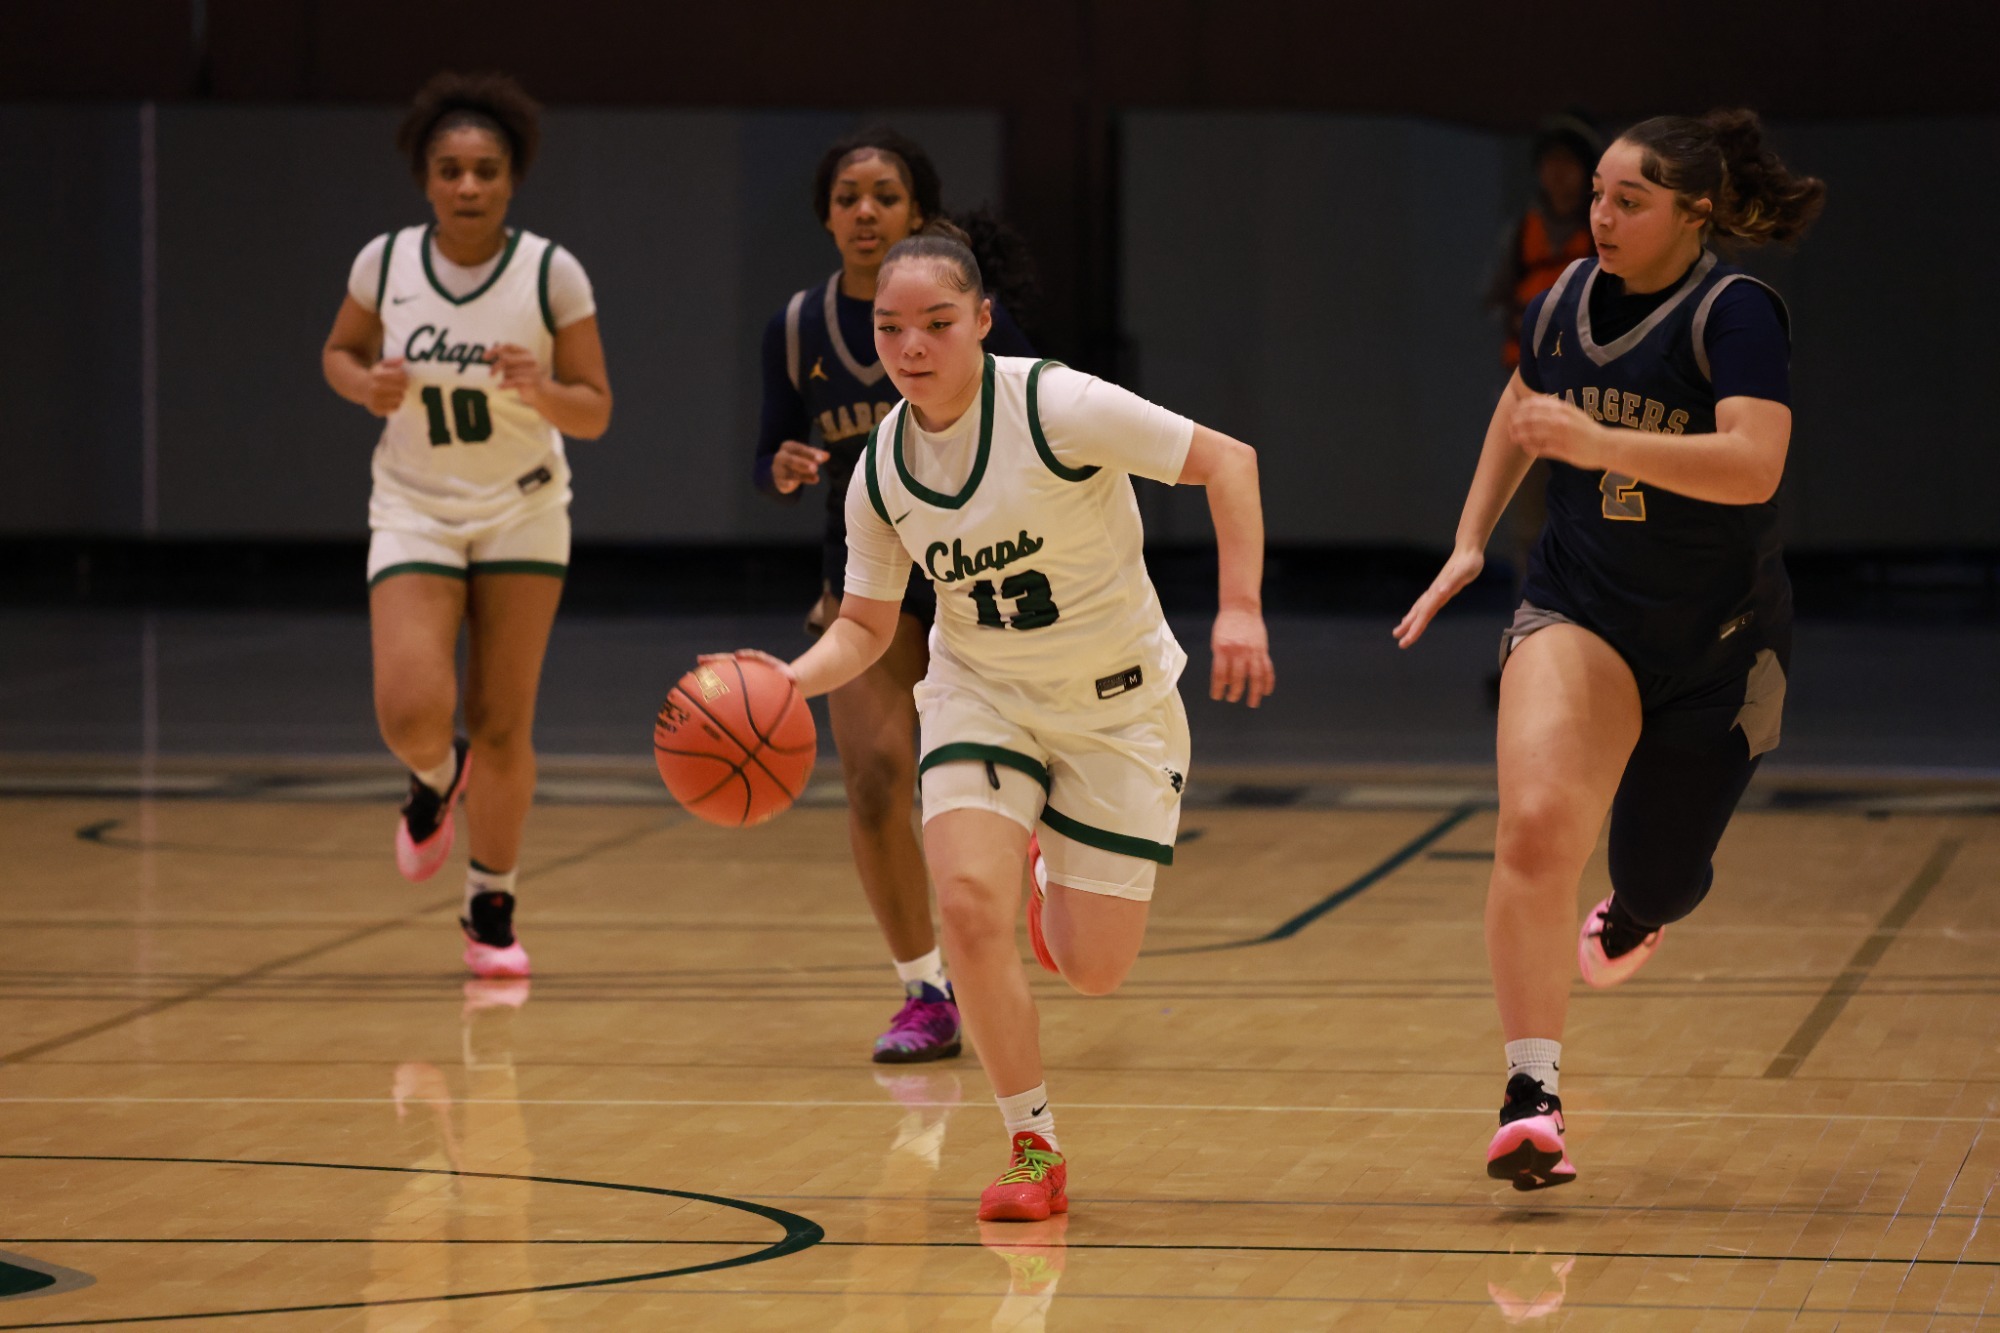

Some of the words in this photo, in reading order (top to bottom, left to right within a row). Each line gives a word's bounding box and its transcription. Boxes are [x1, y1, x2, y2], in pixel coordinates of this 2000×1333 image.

[421, 386, 493, 446] 10
[1550, 386, 1690, 435] ARGERS
[1599, 470, 1646, 521] 2
[925, 530, 1043, 582] Chaps
[968, 569, 1060, 631] 13
[1129, 674, 1138, 685] M
